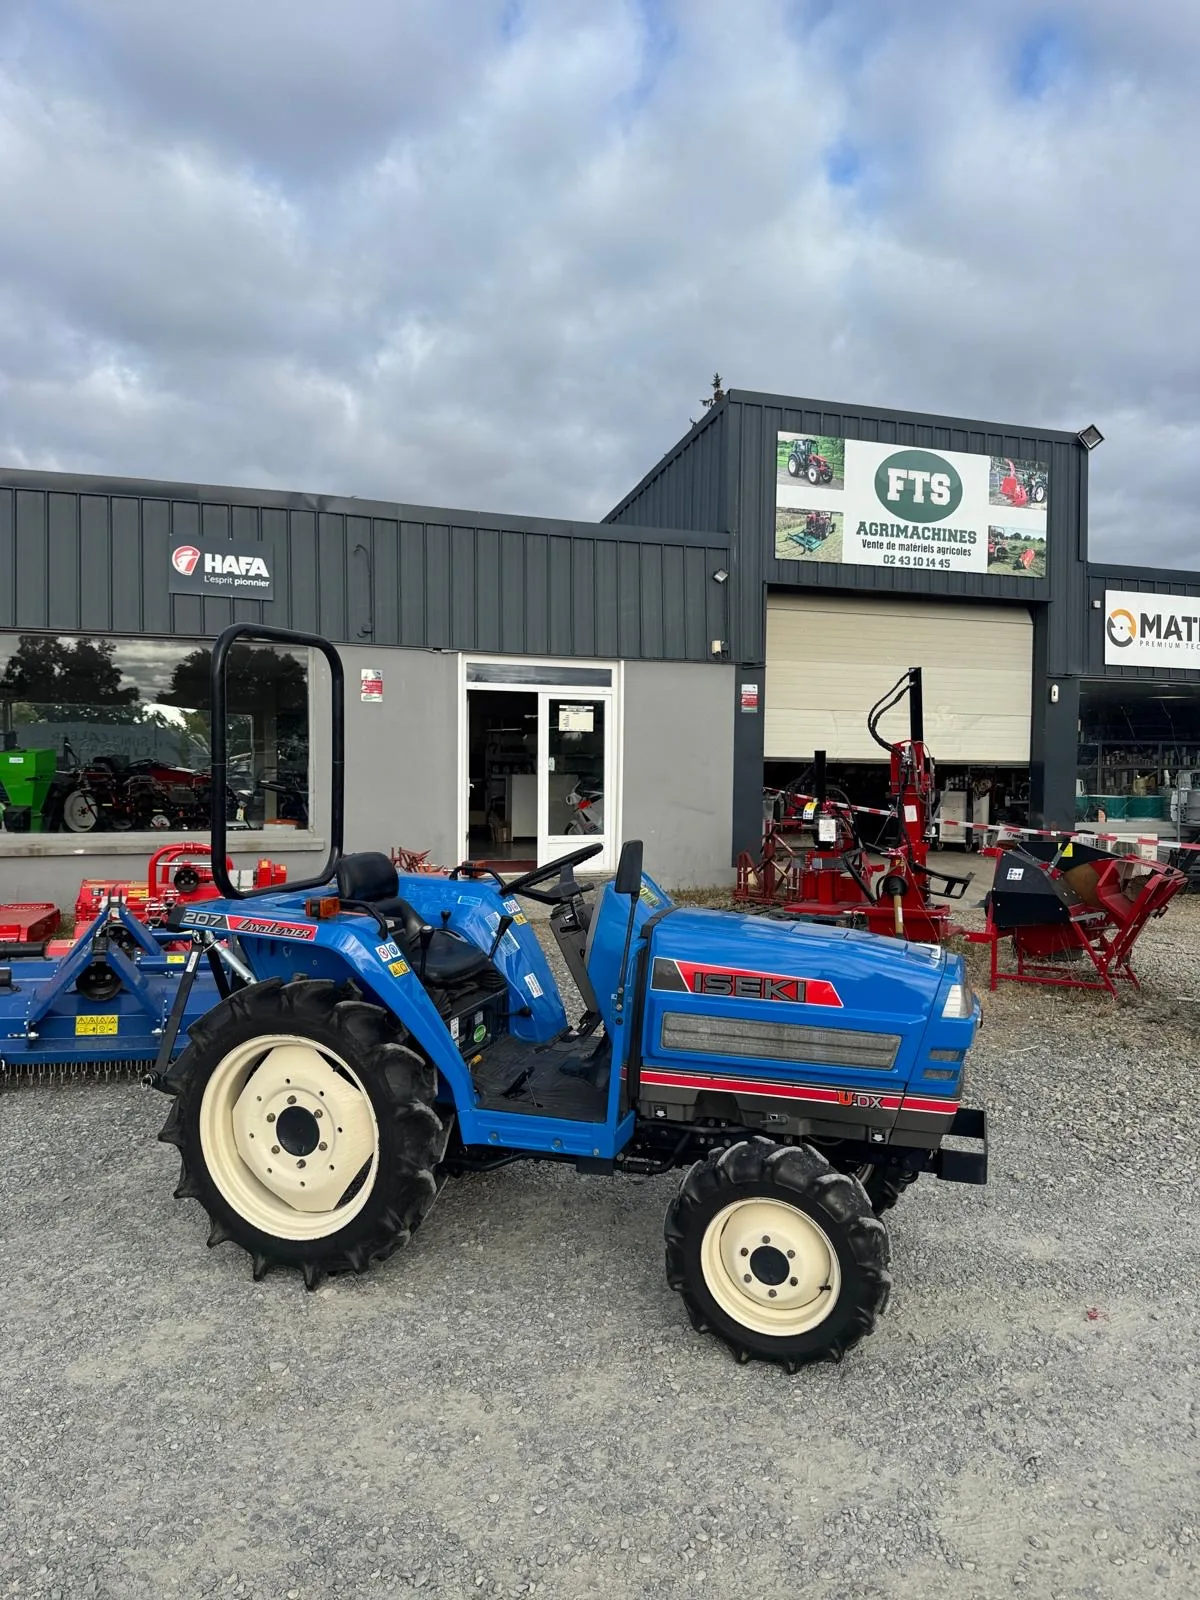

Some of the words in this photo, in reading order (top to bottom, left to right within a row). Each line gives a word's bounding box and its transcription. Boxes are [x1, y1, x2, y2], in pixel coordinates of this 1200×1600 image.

[887, 468, 951, 505] FTS
[856, 521, 977, 544] AGRIMACHINES
[862, 539, 884, 550] Vente
[886, 541, 896, 550] de
[898, 542, 935, 553] matériels
[936, 546, 972, 557] agricoles
[204, 553, 270, 578] HAFA
[883, 554, 896, 565] 02
[898, 555, 911, 565] 43
[912, 557, 924, 567] 10
[926, 558, 936, 568] 14
[938, 559, 951, 568] 45
[204, 575, 233, 585] L'esprit
[234, 578, 270, 588] pionnier
[1140, 612, 1200, 642] MAT
[1140, 640, 1181, 649] PREMIUM
[183, 911, 221, 926] 207
[694, 972, 807, 1003] ISEKI
